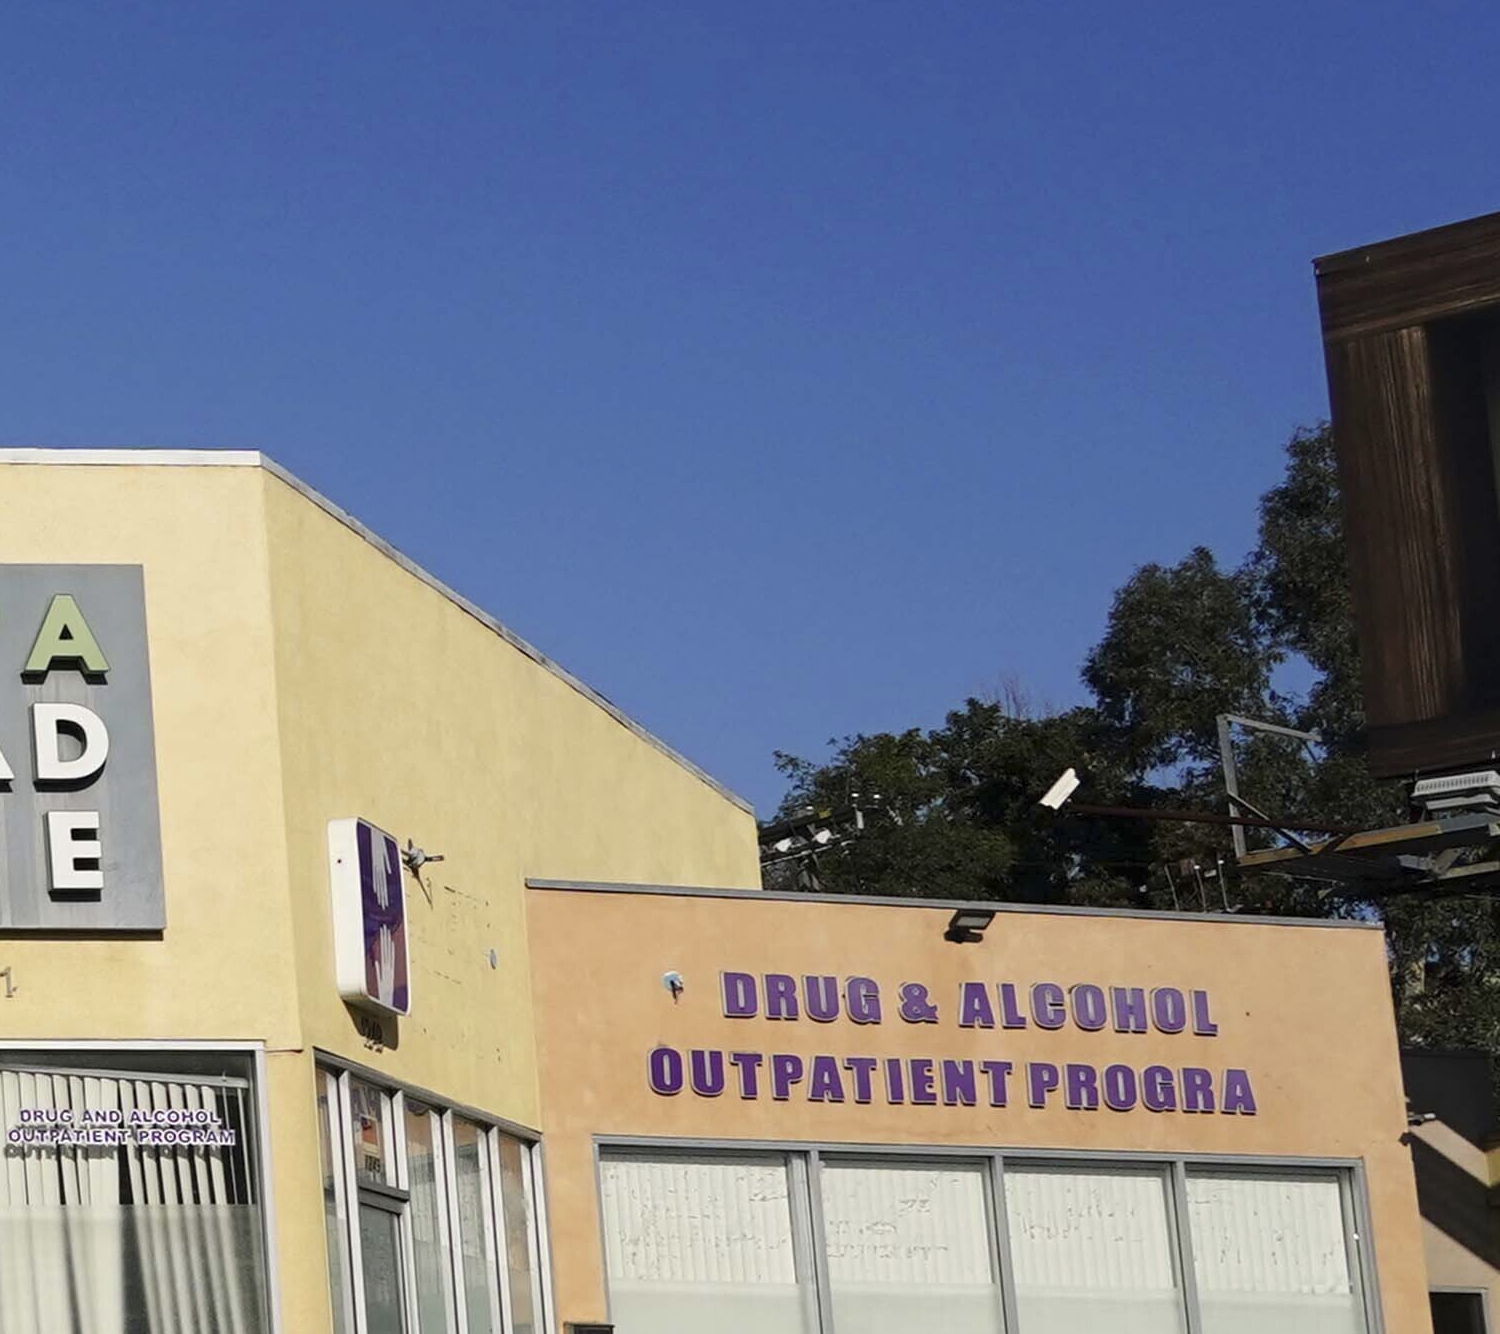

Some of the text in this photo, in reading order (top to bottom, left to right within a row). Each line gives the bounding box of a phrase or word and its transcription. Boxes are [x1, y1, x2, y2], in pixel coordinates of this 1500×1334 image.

[718, 969, 1222, 1039] DRUG & ALCOHOL
[647, 1044, 1260, 1117] OUTPATIENT PROGRA
[7, 1128, 237, 1146] OUTPATIENT PROGRAM
[19, 1108, 223, 1124] DRUG AND ALCOHOL
